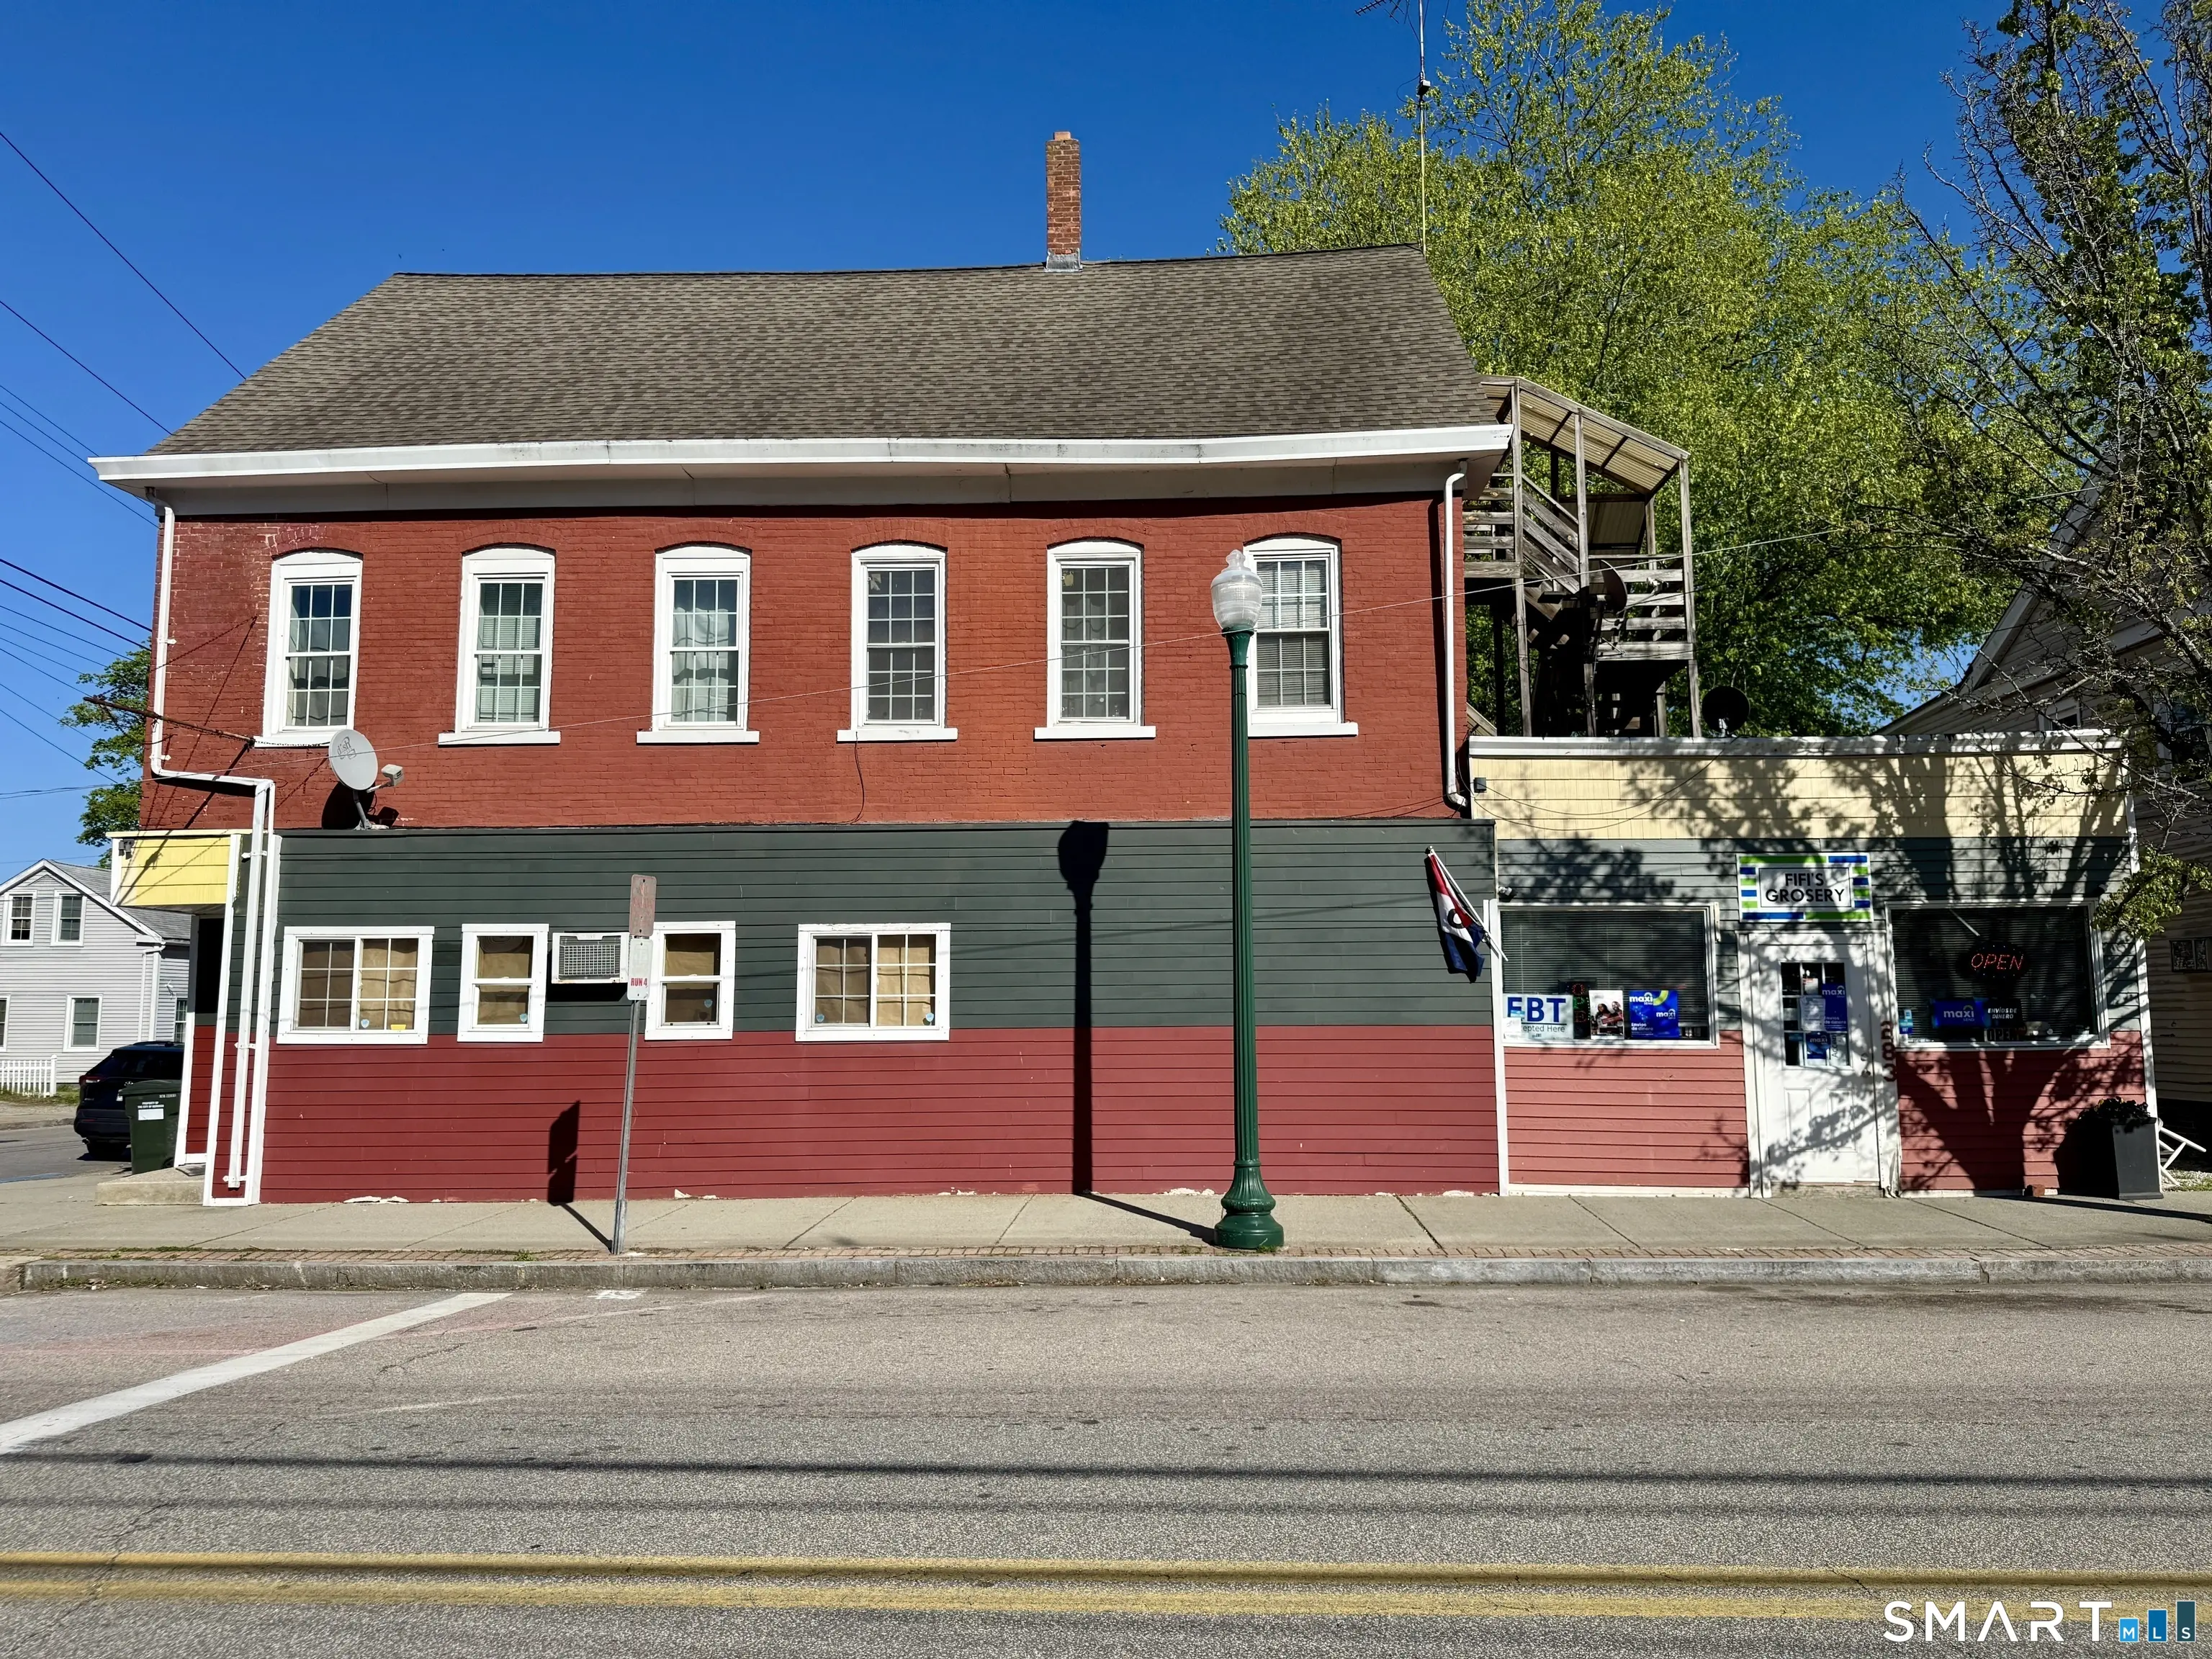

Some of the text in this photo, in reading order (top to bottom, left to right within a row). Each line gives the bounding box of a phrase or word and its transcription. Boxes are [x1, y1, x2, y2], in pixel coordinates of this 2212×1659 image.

[1785, 873, 1824, 886] FIFI'S
[1765, 889, 1845, 902] GROSERY
[1971, 953, 2024, 970] OPEN
[1943, 1010, 1974, 1018] maxi
[1521, 1025, 1545, 1034] epted
